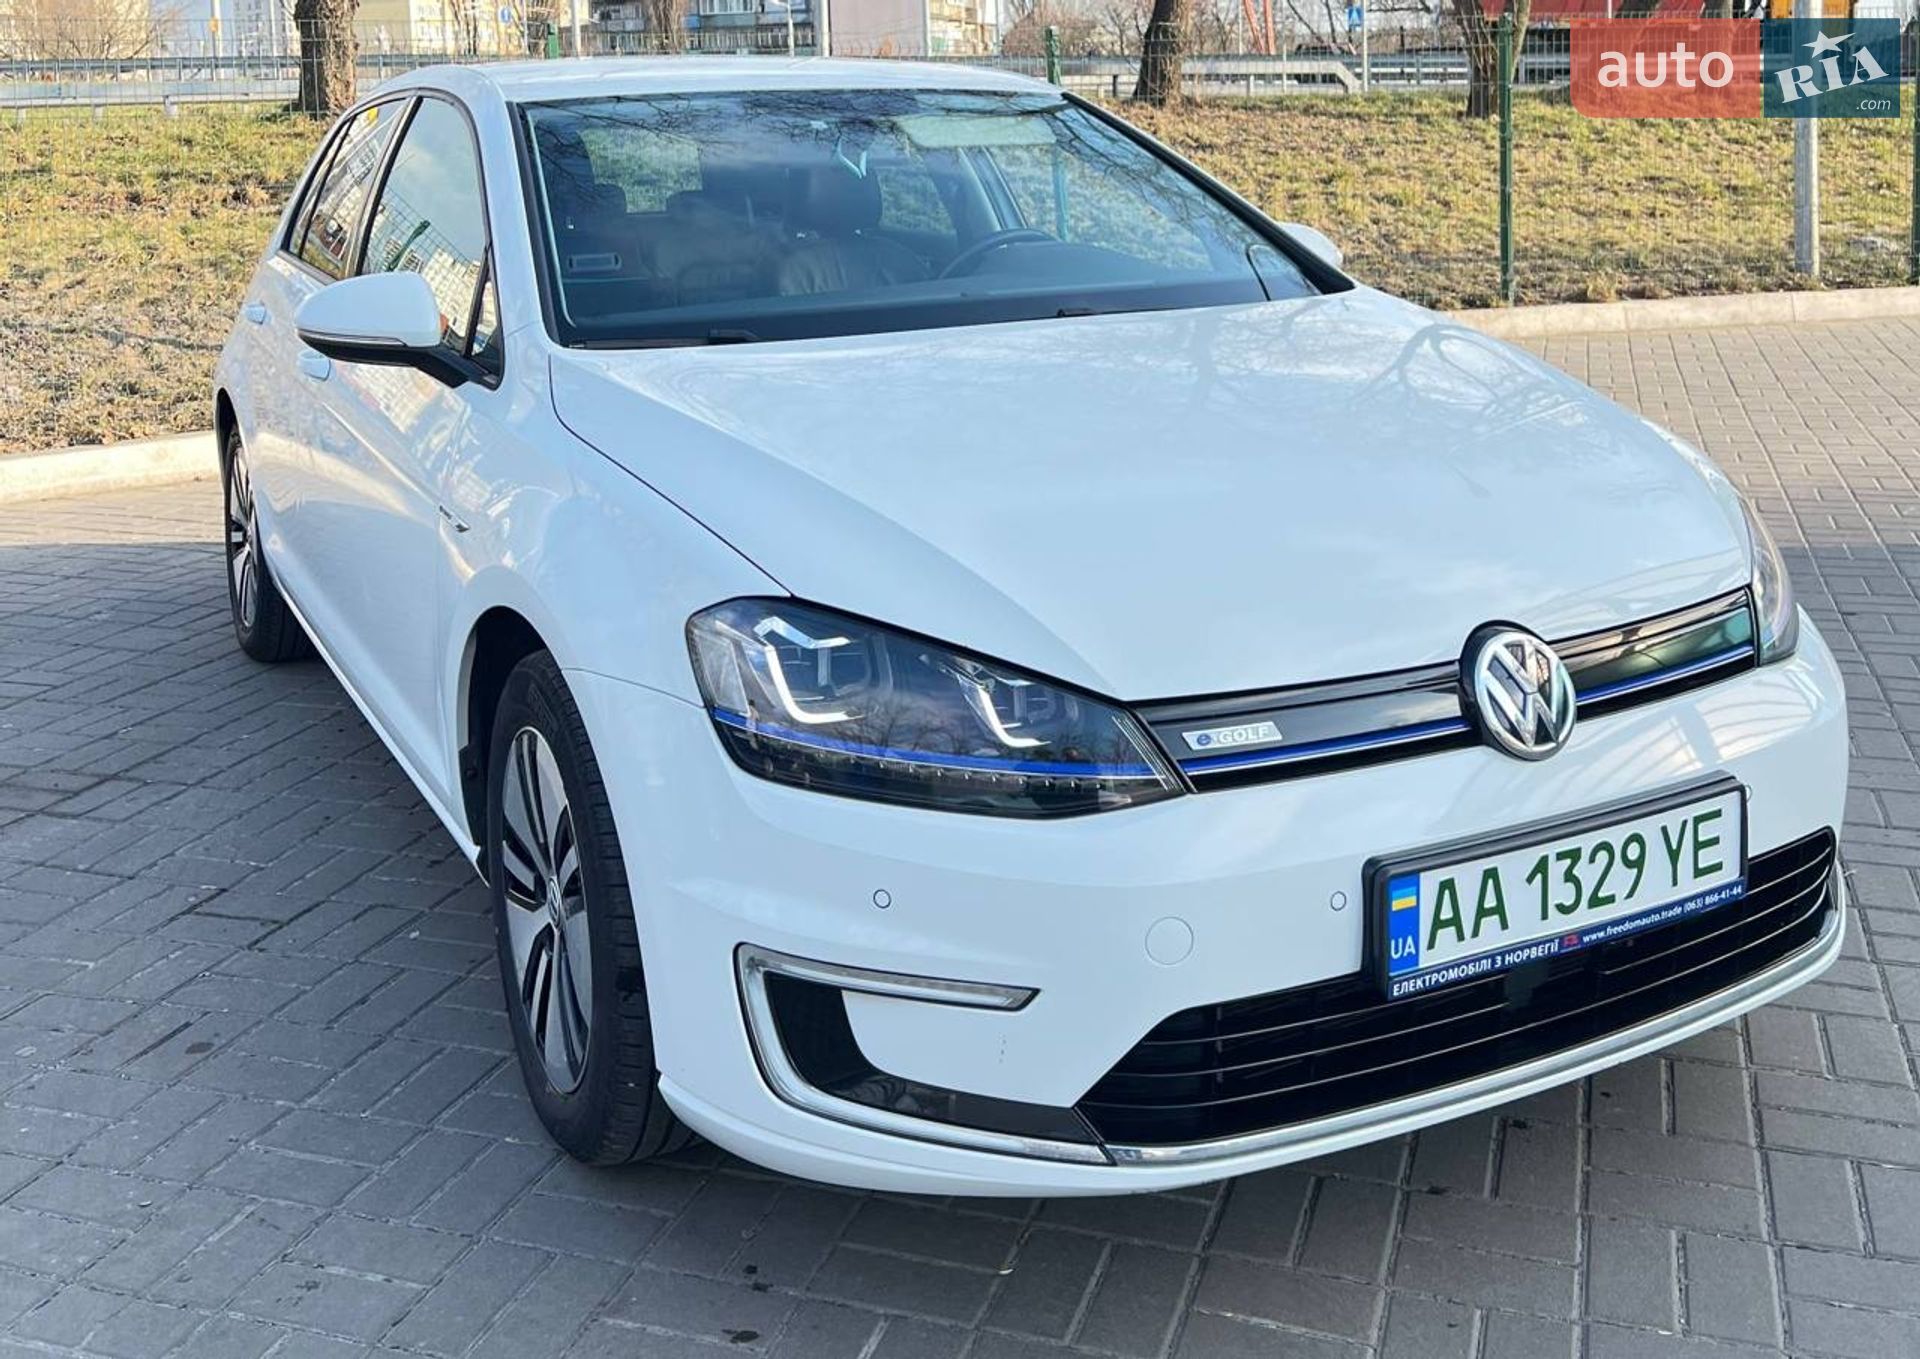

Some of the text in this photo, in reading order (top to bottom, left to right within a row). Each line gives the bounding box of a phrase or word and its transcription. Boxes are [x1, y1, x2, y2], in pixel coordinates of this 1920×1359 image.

[1426, 808, 1724, 951] AA 1329 YE
[1390, 936, 1416, 960] UA
[1393, 961, 1491, 997] ЕЛЕКТРОМОБІЛІ
[1505, 939, 1560, 966] НОРВЕГІЇ
[1582, 905, 1683, 943] www.freedomauto.trade
